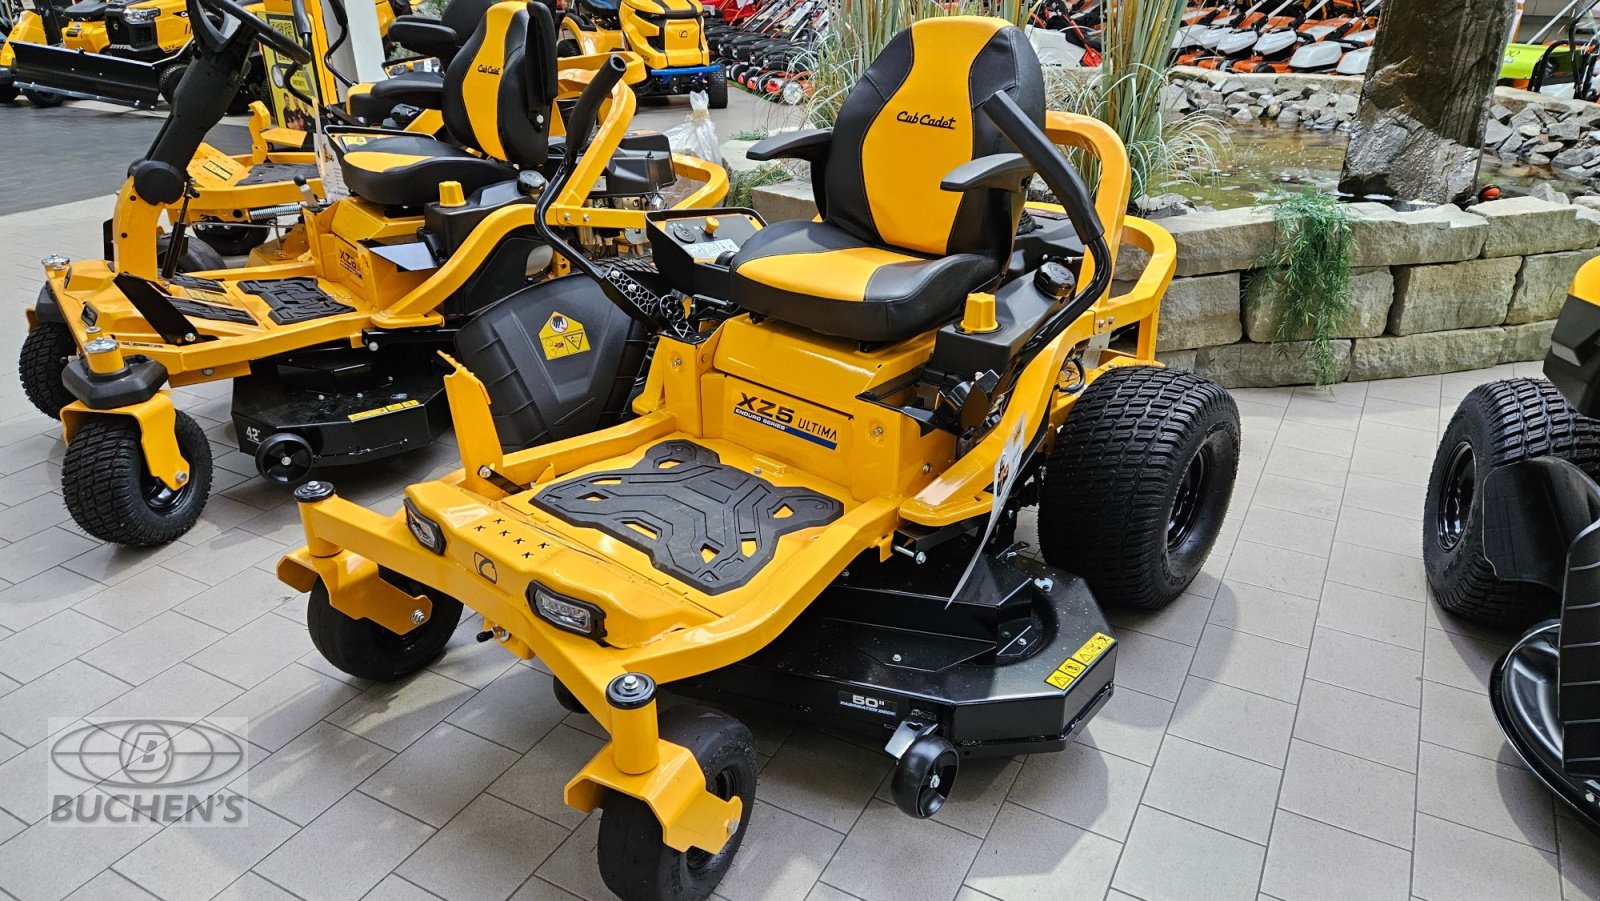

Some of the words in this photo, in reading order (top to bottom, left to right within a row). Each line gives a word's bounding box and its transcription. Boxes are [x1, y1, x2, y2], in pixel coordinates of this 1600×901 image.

[896, 110, 919, 124] Cub
[920, 114, 956, 130] Cadet
[735, 408, 762, 423] ENDURO
[762, 417, 786, 431] SERIES
[736, 392, 795, 424] XZ5
[797, 418, 837, 441] ULTIMA
[852, 694, 885, 708] 50"
